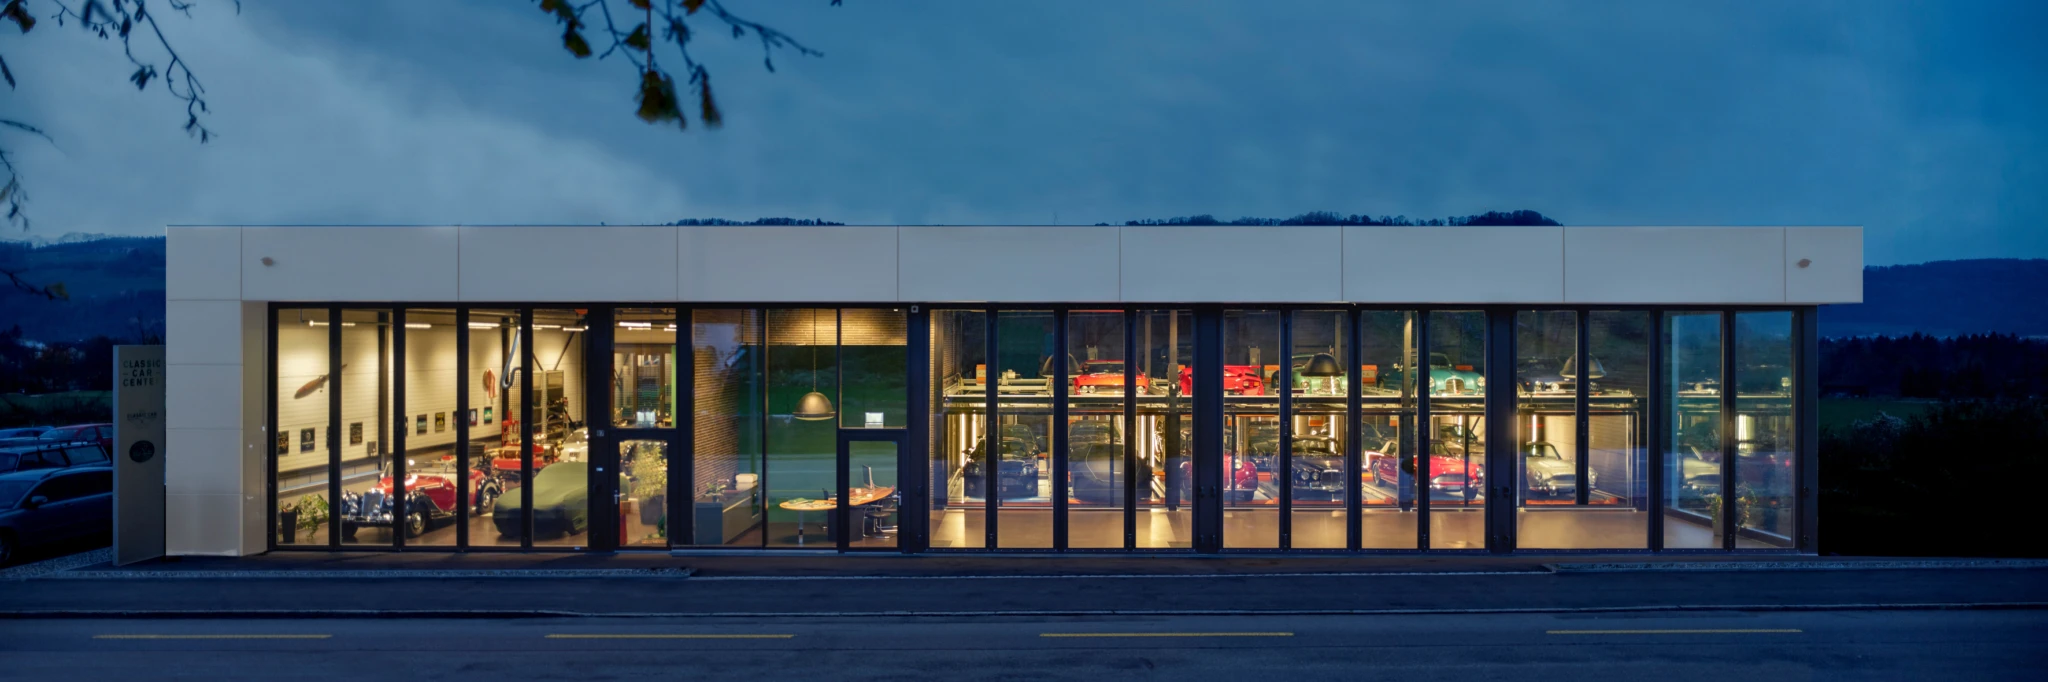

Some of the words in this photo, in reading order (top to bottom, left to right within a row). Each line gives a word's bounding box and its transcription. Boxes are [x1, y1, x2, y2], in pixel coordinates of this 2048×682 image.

[123, 358, 161, 368] CLASSIC
[132, 368, 152, 377] CAR
[123, 377, 160, 387] CENTE
